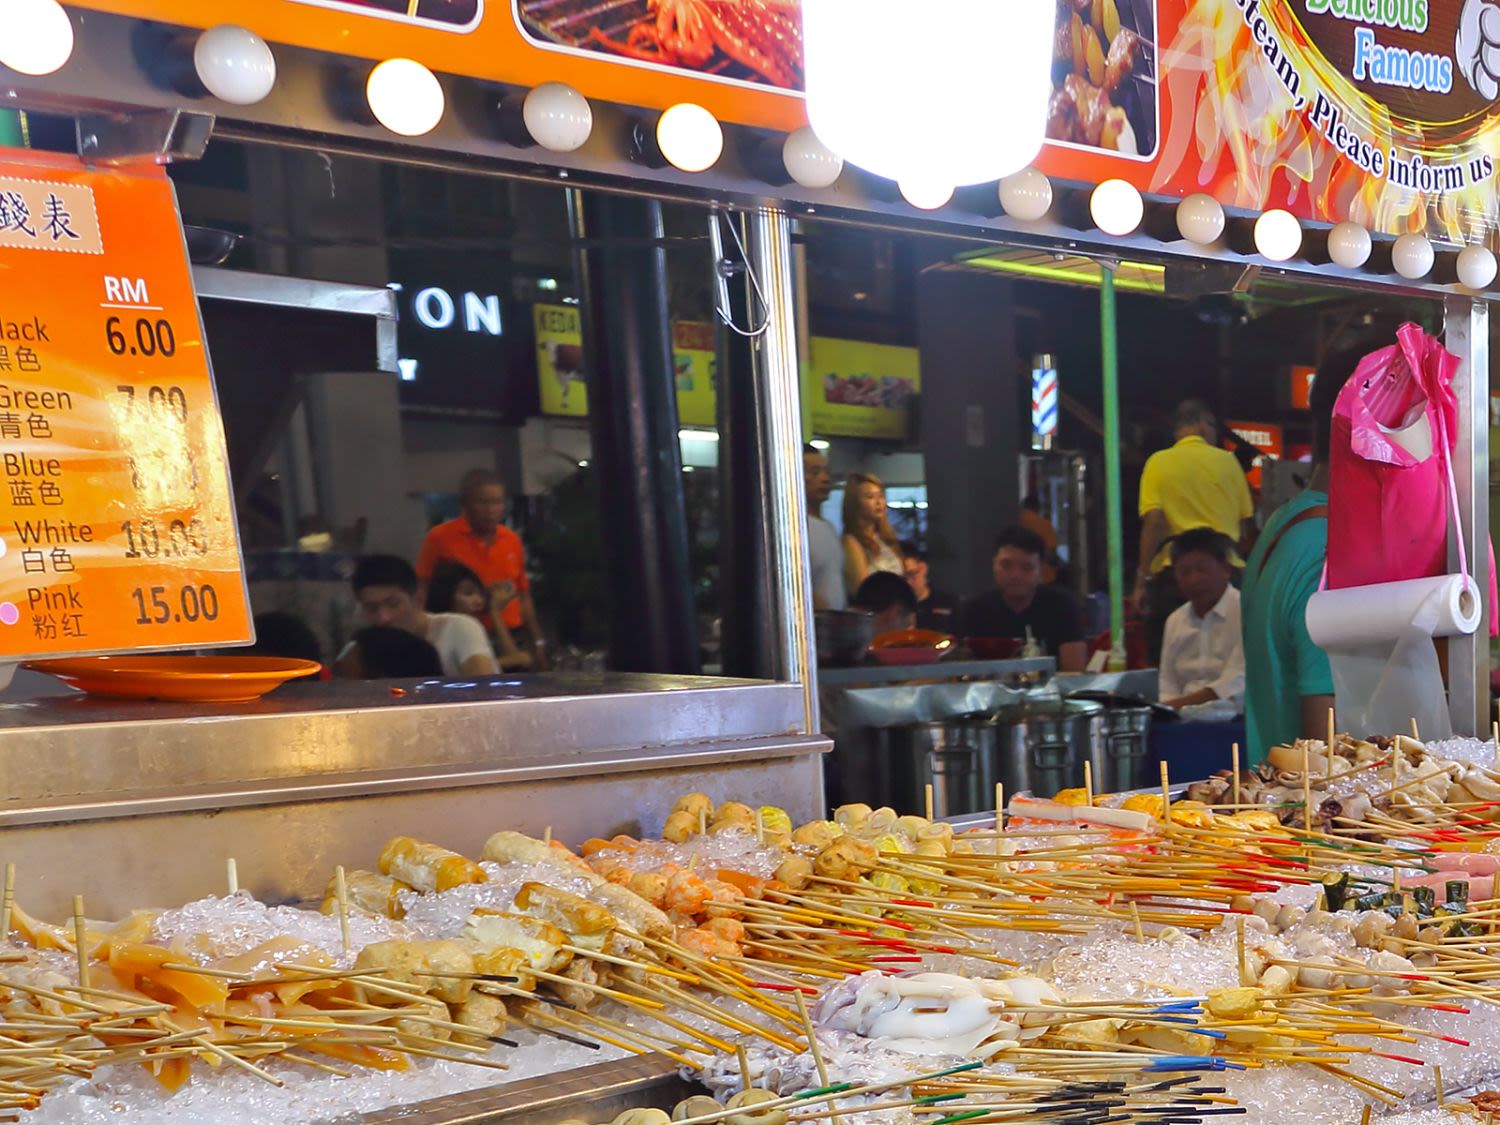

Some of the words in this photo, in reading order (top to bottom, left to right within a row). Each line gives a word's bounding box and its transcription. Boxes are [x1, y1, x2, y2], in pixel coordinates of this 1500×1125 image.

[1353, 26, 1452, 93] Famous
[1236, 0, 1304, 108] team,
[1308, 89, 1384, 176] Please
[1387, 150, 1464, 192] inform
[1470, 153, 1493, 184] us
[103, 275, 150, 303] RM
[386, 282, 503, 336] ON
[105, 316, 176, 358] 6.00
[4, 452, 62, 477] Blue
[8, 480, 64, 507] 蓝色
[14, 519, 94, 544] White
[21, 547, 76, 575] 白色
[27, 584, 84, 611] Pink
[131, 584, 220, 626] 15.00
[32, 613, 88, 640] 粉红
